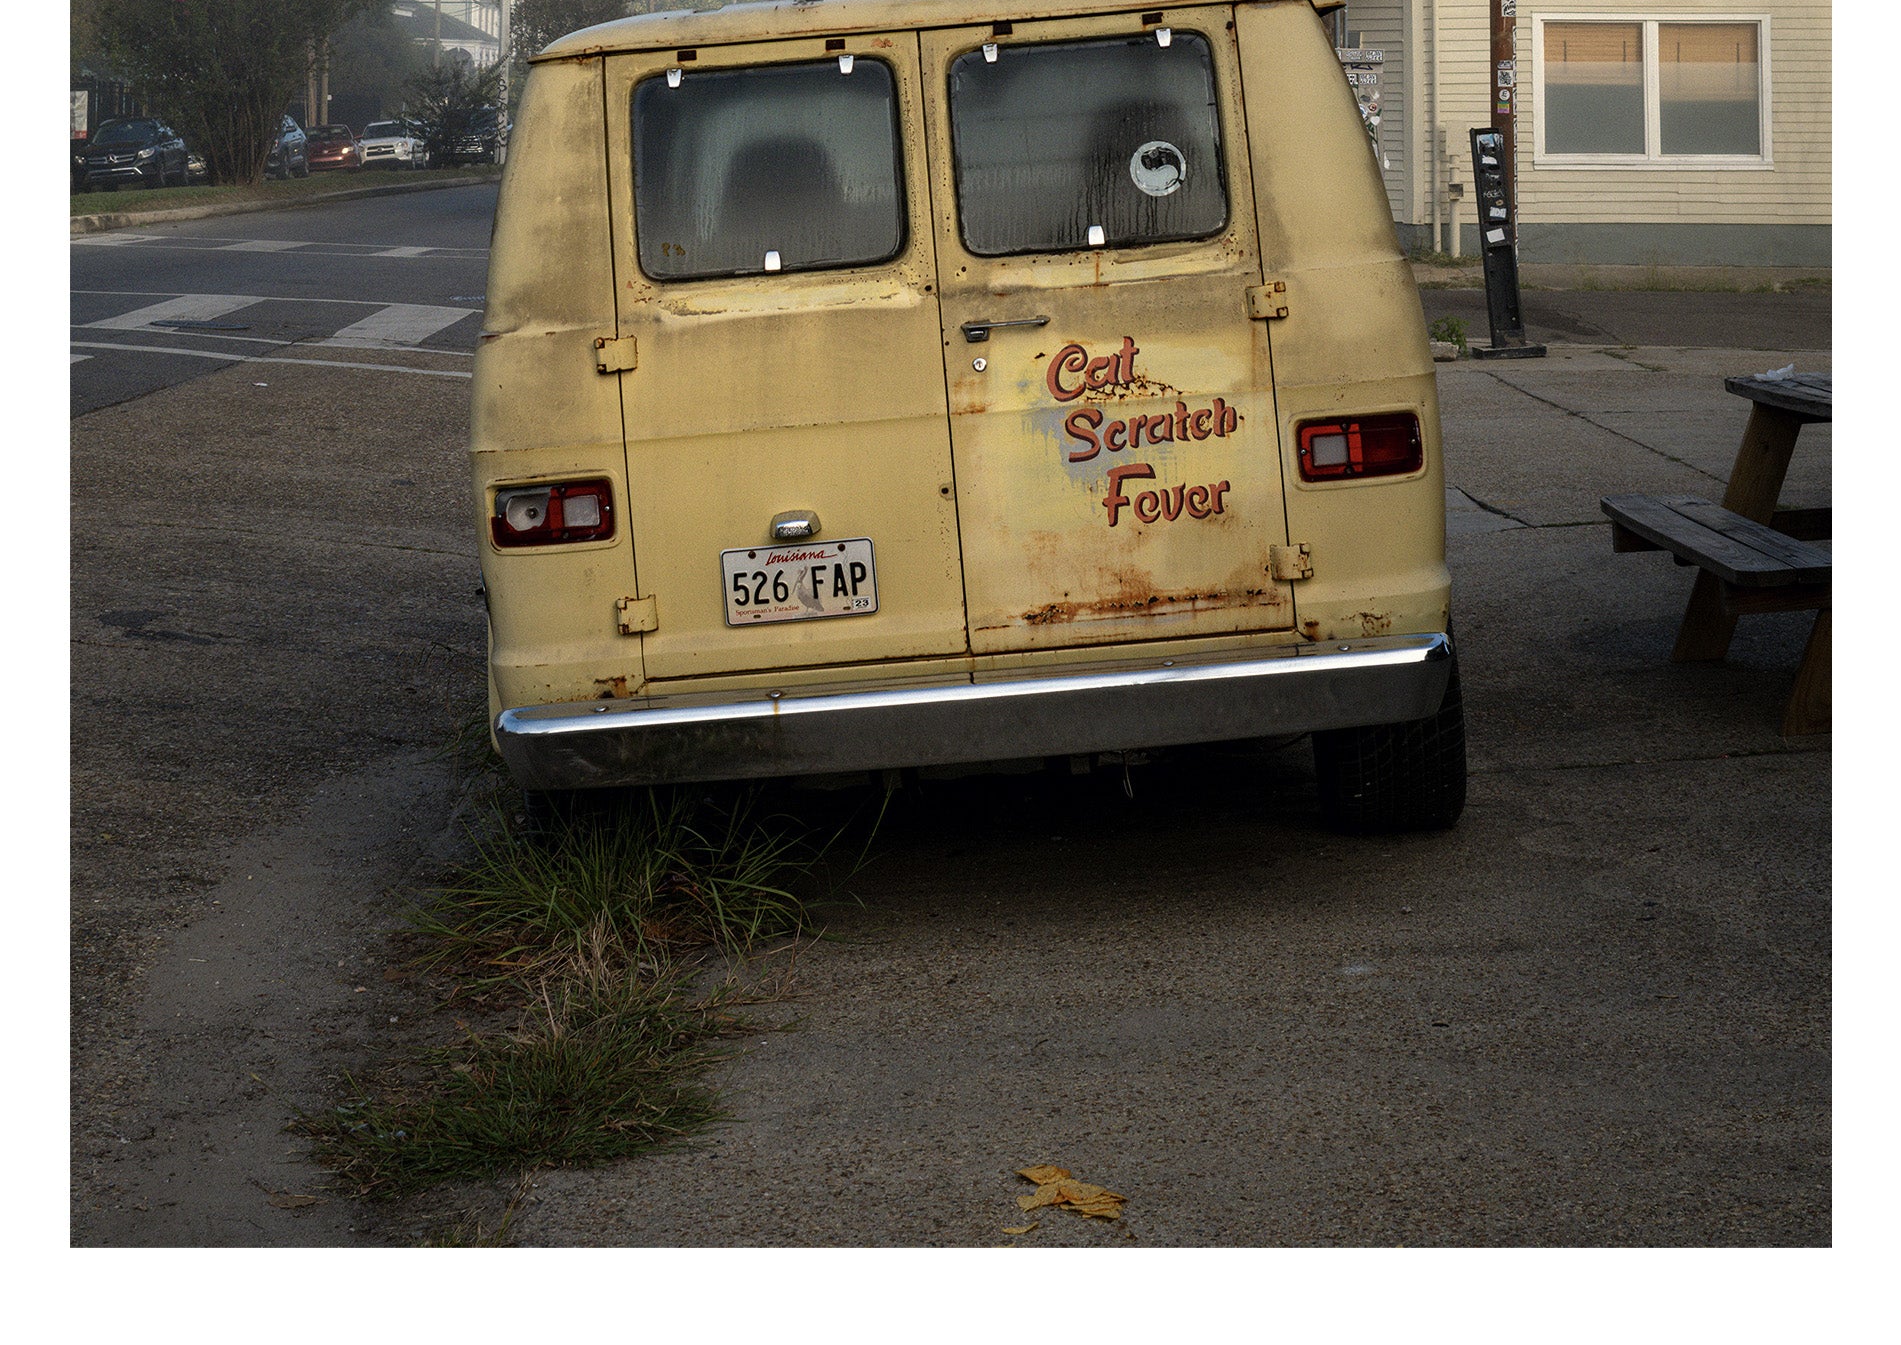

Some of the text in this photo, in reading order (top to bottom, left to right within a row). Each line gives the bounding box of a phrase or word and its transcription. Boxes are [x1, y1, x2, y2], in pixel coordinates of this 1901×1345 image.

[1047, 336, 1140, 402] Cat
[1065, 397, 1238, 463] Scratch
[1102, 463, 1231, 527] Fever
[765, 550, 838, 566] Louisiana
[733, 562, 867, 606] 526 FAP
[855, 599, 869, 607] 23
[774, 604, 800, 612] Paradise
